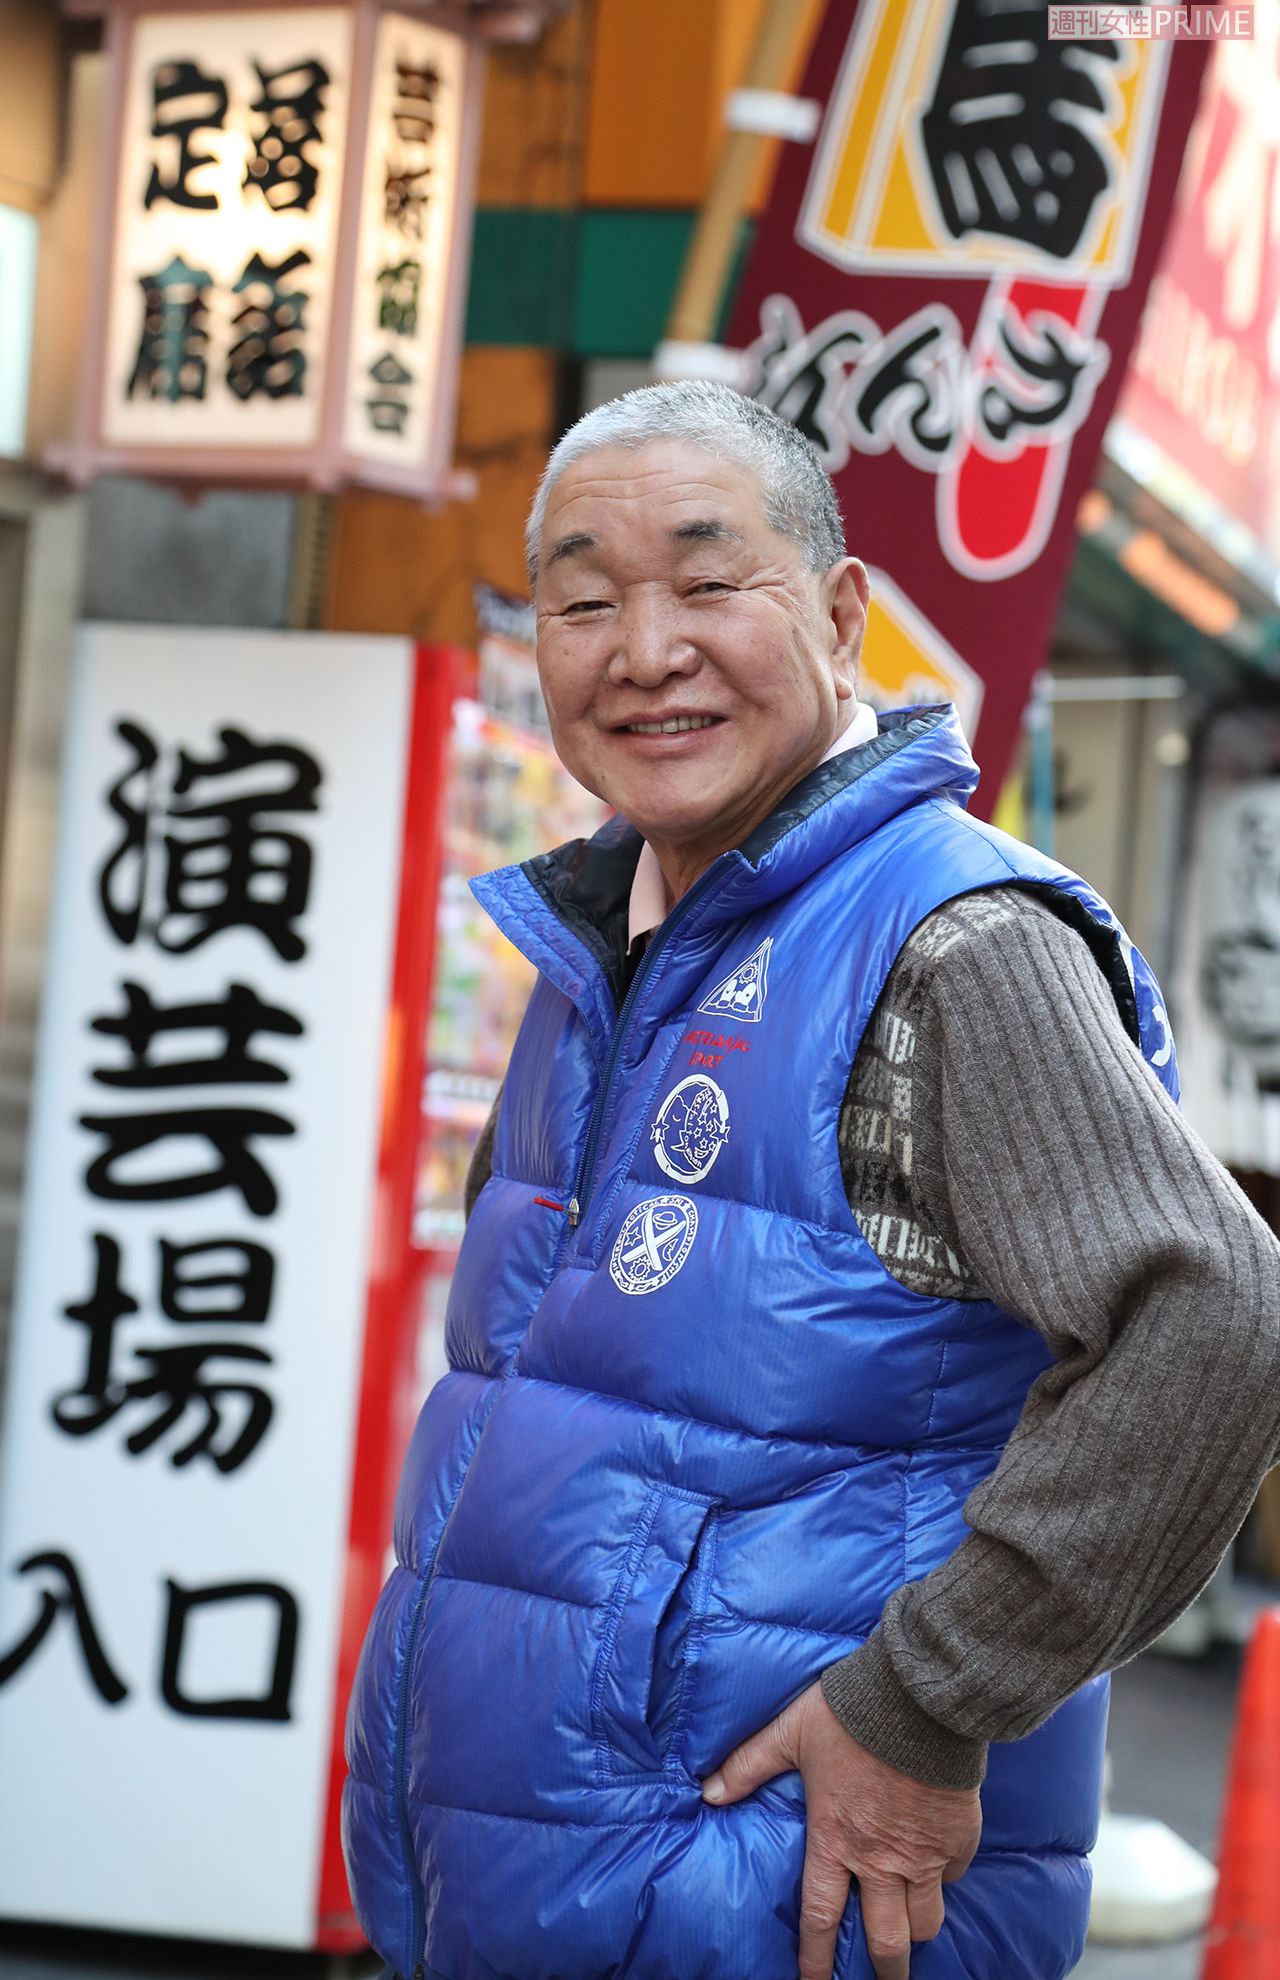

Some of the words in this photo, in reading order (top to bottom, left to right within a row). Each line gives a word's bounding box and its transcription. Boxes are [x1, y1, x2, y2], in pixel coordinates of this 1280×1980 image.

[51, 720, 323, 1473] 演芸場
[0, 1550, 300, 1723] 入口
